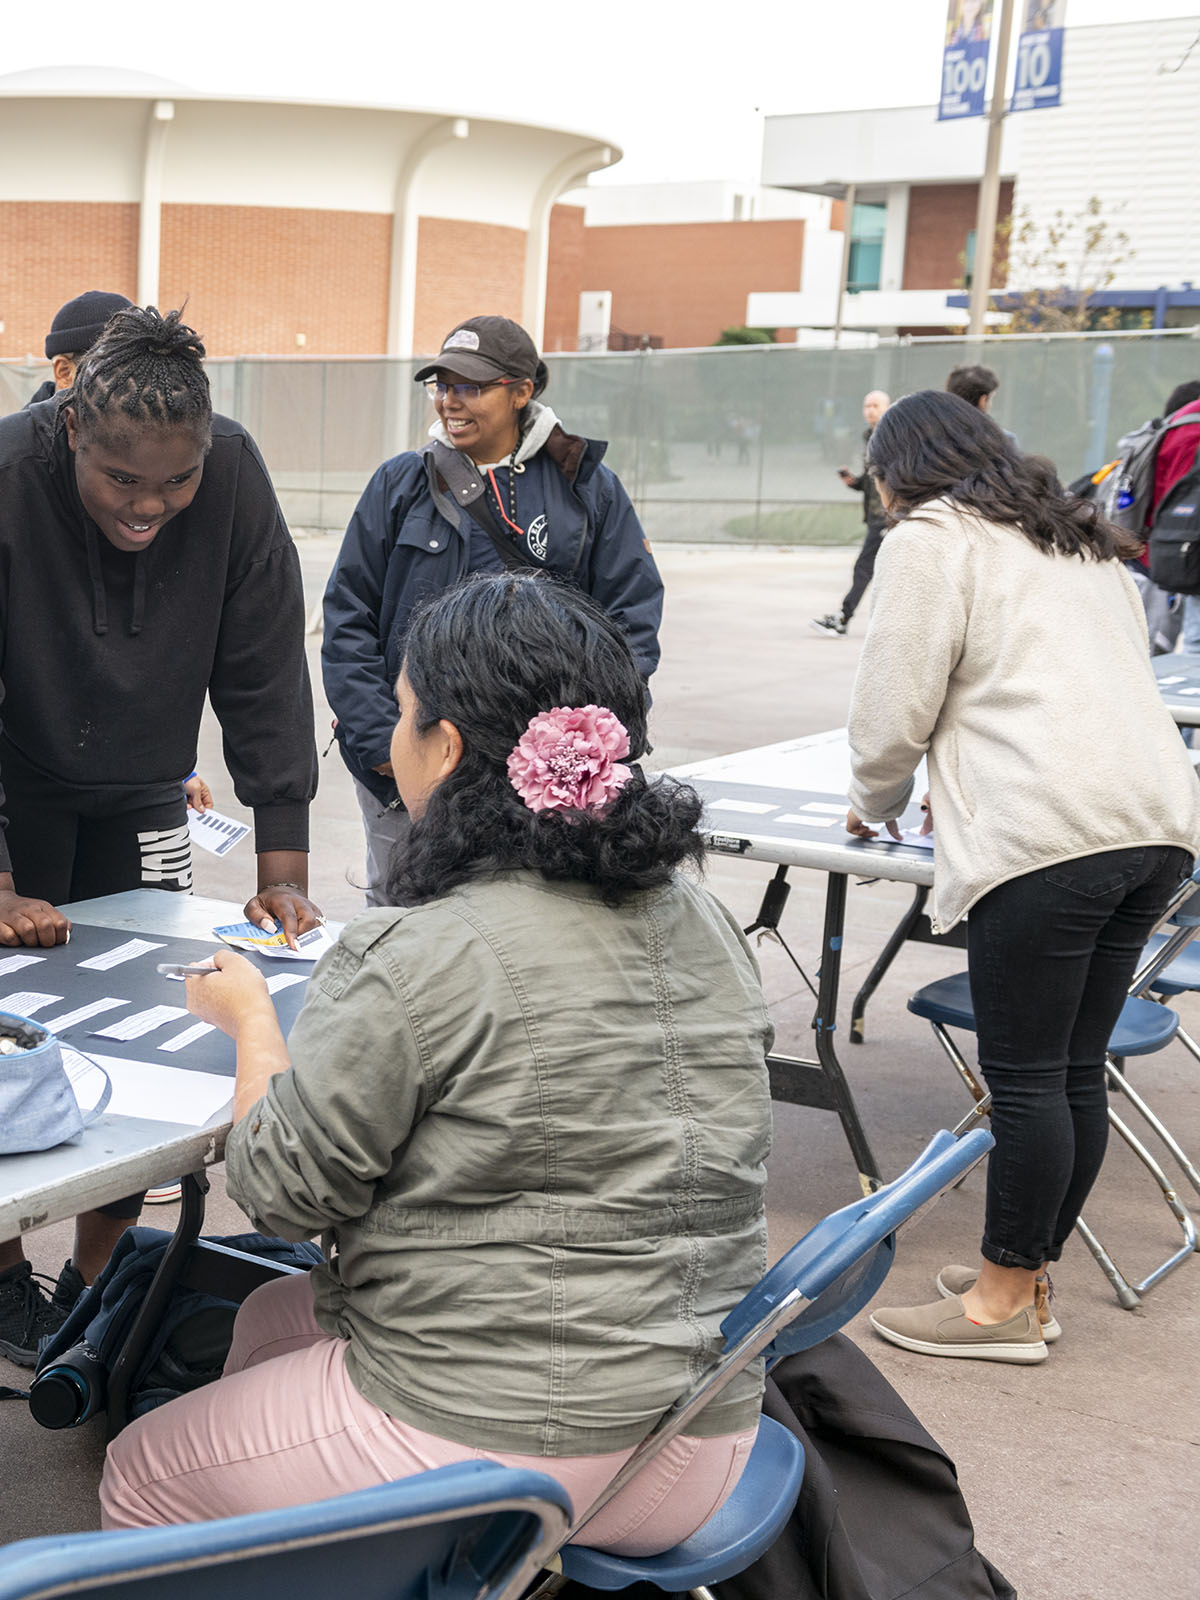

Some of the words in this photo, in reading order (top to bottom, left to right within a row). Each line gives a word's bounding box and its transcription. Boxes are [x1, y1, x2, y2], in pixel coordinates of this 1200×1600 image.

[944, 57, 986, 95] 100
[1018, 45, 1050, 87] 10
[532, 543, 547, 558] COL
